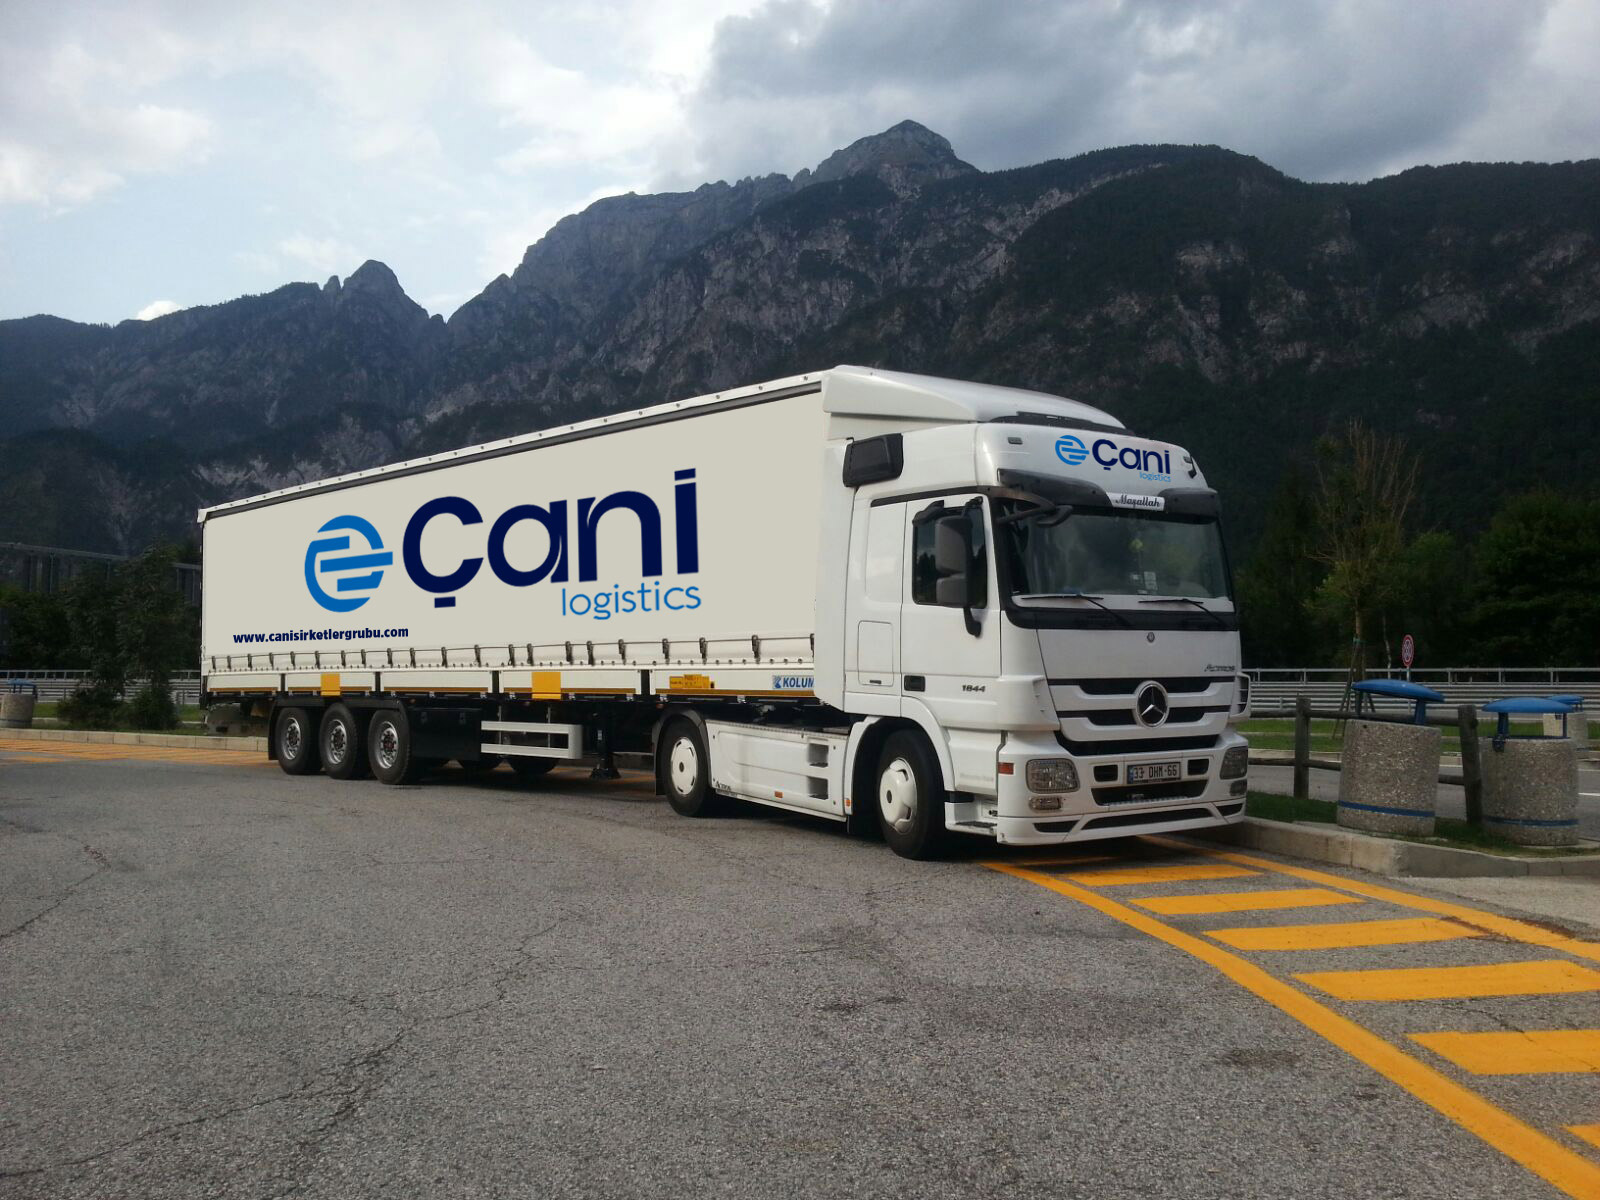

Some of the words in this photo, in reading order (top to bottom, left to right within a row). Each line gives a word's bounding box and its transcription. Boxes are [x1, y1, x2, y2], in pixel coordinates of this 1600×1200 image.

[1092, 438, 1171, 474] Çani
[1139, 472, 1171, 482] logistics
[403, 467, 699, 608] Çani
[562, 580, 702, 620] logistics
[233, 627, 409, 644] www.canisirketlergrubu.com
[962, 684, 986, 692] 1844
[1133, 767, 1144, 778] 33
